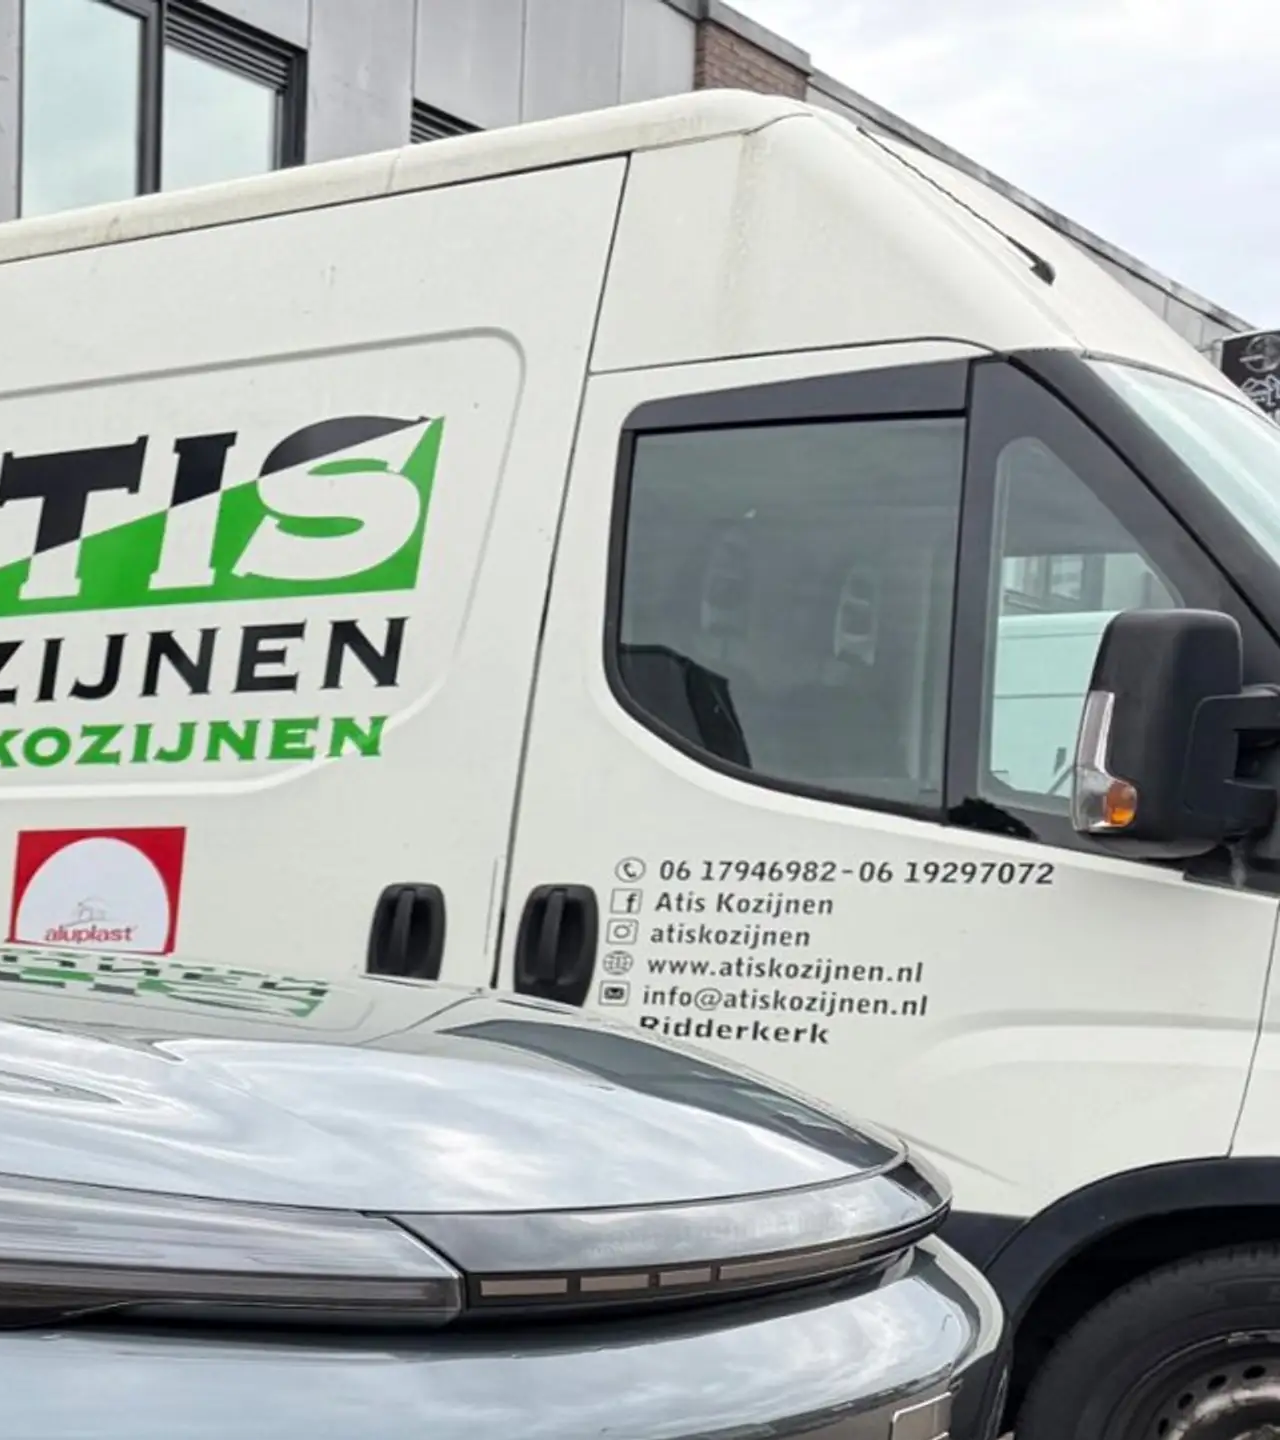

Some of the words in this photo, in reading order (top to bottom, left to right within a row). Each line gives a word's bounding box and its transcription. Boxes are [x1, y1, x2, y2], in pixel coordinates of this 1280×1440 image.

[658, 859, 691, 882] 06
[904, 861, 1056, 885] 19297072
[654, 891, 706, 913] Atis
[715, 892, 834, 918] Kozijnen
[44, 923, 134, 945] aluplast
[650, 923, 811, 950] atiskozijnen
[647, 956, 924, 984] www.atiskozijnen.nl
[642, 985, 928, 1017] info@atiskozijnen.nl
